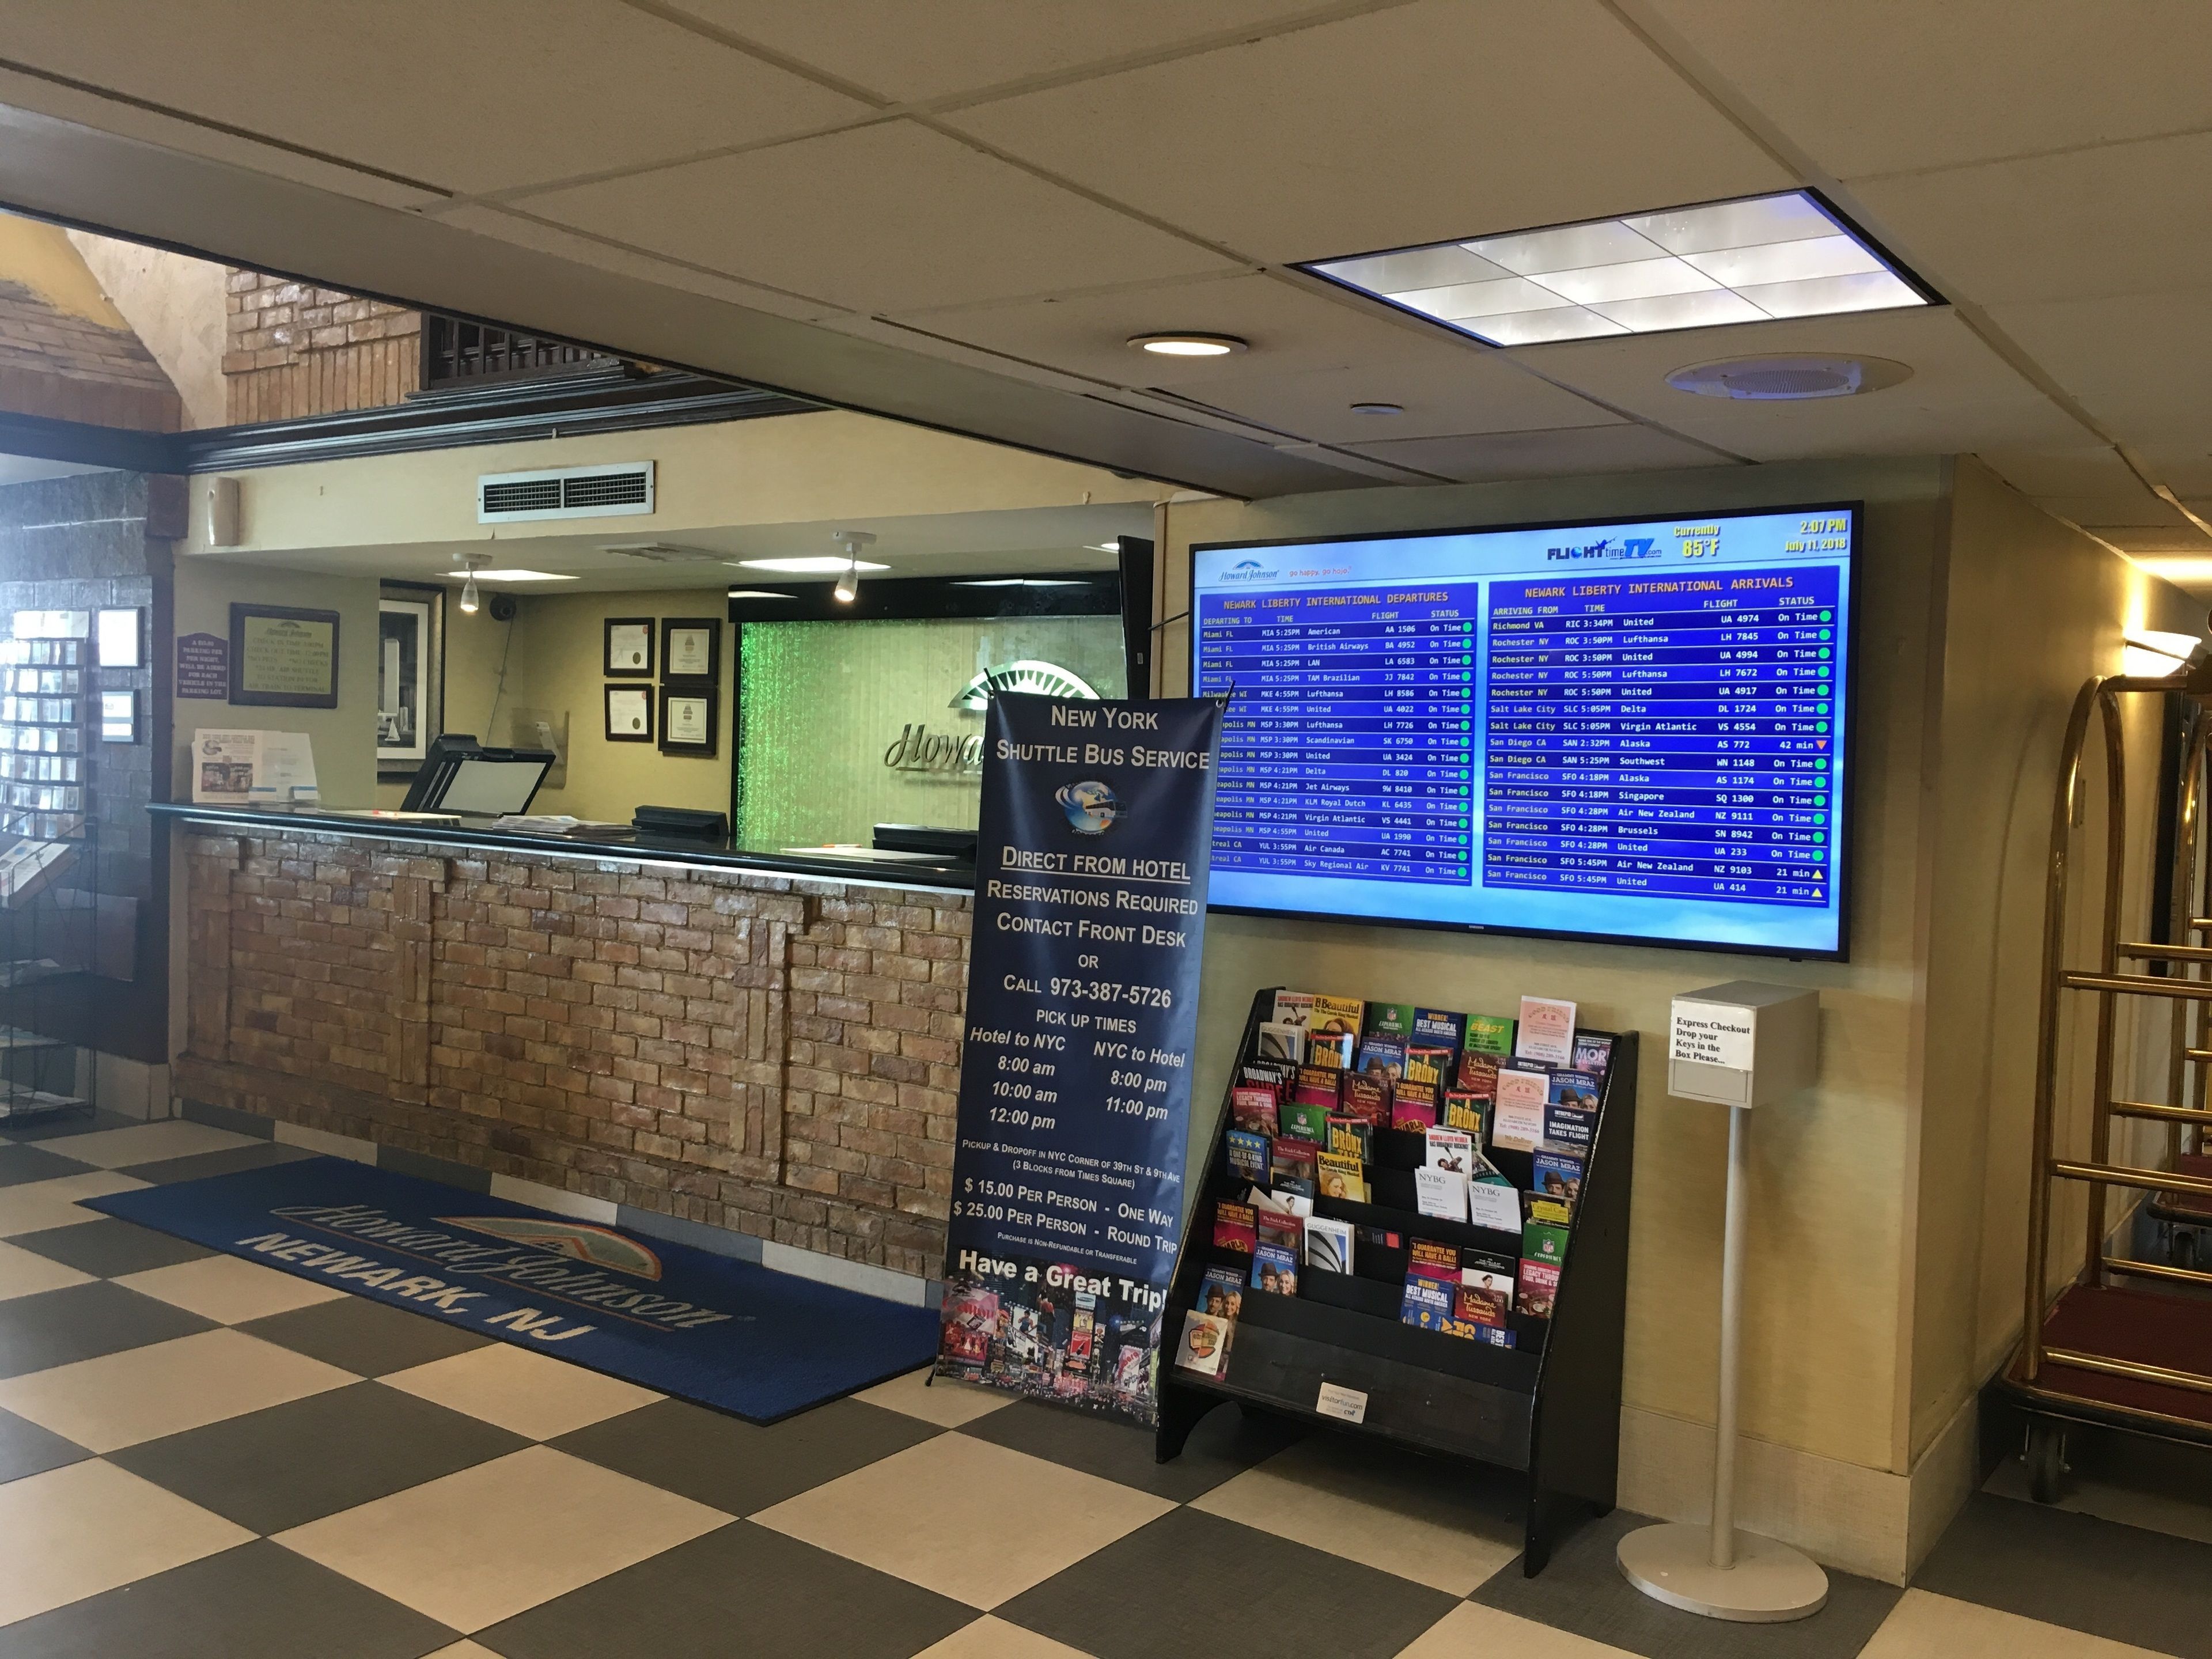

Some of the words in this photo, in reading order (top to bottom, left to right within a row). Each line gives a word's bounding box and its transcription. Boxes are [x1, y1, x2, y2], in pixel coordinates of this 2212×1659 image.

[1673, 524, 1721, 537] Currently
[1800, 520, 1825, 534] 2:07
[1827, 519, 1846, 533] PM
[1682, 538, 1721, 558] 85°F
[1785, 540, 1805, 552] July
[1807, 540, 1821, 552] 11,
[1823, 537, 1846, 550] 2018
[1219, 569, 1246, 582] Howard
[1247, 568, 1278, 582] Johnson
[1323, 568, 1331, 576] go
[1525, 587, 1566, 599] NEWARK
[1573, 584, 1622, 596] LIBERTY
[1628, 580, 1723, 594] INTERNATIONAL
[1731, 577, 1794, 590] ARRIVALS
[1224, 600, 1256, 610] NEWARK
[1262, 597, 1300, 609] LIBERTY
[1306, 594, 1381, 607] INTERNATIONAL
[1387, 592, 1448, 604] DEPARTURES
[1494, 607, 1533, 615] ARRIVING
[1537, 606, 1558, 615] FROM
[1585, 604, 1605, 612] TIME
[1703, 599, 1738, 608] FLIGHT
[1779, 597, 1815, 606] STATUS
[1203, 617, 1240, 626] DEPARTING
[1372, 611, 1399, 620] FLIGHT
[1431, 609, 1459, 618] STATUS
[1493, 621, 1530, 631] Richmond
[1534, 621, 1544, 629] VA
[1584, 619, 1613, 627] 3:34PM
[1623, 617, 1654, 626] United
[1721, 615, 1732, 623] UA
[1737, 613, 1759, 623] 4974
[1778, 613, 1790, 622] On
[1794, 612, 1818, 621] Time
[1051, 705, 1096, 727] NEW
[1102, 707, 1158, 730] YORK
[884, 724, 984, 767] Howa
[997, 739, 1077, 763] SHUTTLE
[1085, 744, 1124, 766] BUS
[1131, 745, 1209, 769] SERVICE
[1002, 845, 1067, 870] DIRECT
[1074, 855, 1126, 875] FROM
[1132, 859, 1190, 880] HOTEL
[987, 880, 1109, 907] RESERVATIONS
[1116, 890, 1198, 915] REQUIRED
[997, 912, 1073, 937] CONTACT
[1078, 920, 1136, 942] FRONT
[1142, 925, 1185, 948] DESK
[1078, 954, 1099, 969] OR
[1003, 974, 1042, 994] CALL
[1050, 977, 1172, 1007] 973-387-5726
[1036, 1009, 1066, 1026] PICK
[1071, 1013, 1089, 1028] UP
[1094, 1016, 1137, 1033] TIMES
[1471, 1022, 1505, 1033] BEAST
[1677, 1017, 1708, 1028] Express
[1710, 1022, 1751, 1034] Checkout
[970, 1027, 1010, 1045] Hotel
[1014, 1032, 1029, 1047] to
[1033, 1033, 1066, 1051] NYC
[1676, 1028, 1696, 1039] Drop
[1699, 1032, 1718, 1041] your
[1094, 1041, 1128, 1059] NYC
[1131, 1046, 1146, 1062] to
[1150, 1048, 1185, 1068] Hotel
[1676, 1039, 1695, 1050] Keys
[1698, 1041, 1705, 1050] in
[1707, 1043, 1720, 1052] the
[998, 1055, 1029, 1073] 8:00
[1033, 1062, 1055, 1076] am
[1675, 1050, 1691, 1059] Box
[1694, 1052, 1725, 1065] Please...
[1111, 1070, 1142, 1088] 8:00
[1144, 1078, 1167, 1093] pm
[1243, 1067, 1283, 1085] BROADWAY'S
[1552, 1076, 1574, 1084] JASON
[1576, 1080, 1595, 1088] MRAZ
[992, 1081, 1032, 1099] 10:00
[1035, 1088, 1058, 1103] am
[1105, 1096, 1143, 1115] 11:00
[1145, 1105, 1168, 1121] pm
[1465, 1098, 1471, 1108] A
[989, 1107, 1029, 1125] 12:00
[1031, 1114, 1056, 1130] pm
[1450, 1104, 1481, 1132] BRONX
[1549, 1120, 1589, 1133] IMAGINATION
[1549, 1128, 1567, 1137] TAKES
[1569, 1130, 1589, 1140] FLIGHT
[962, 1139, 991, 1150] PICKUP
[993, 1143, 999, 1152] &
[1002, 1143, 1036, 1157] DROPOFF
[1039, 1150, 1046, 1158] IN
[1048, 1150, 1066, 1161] NYC
[1068, 1154, 1099, 1167] CORNER
[1101, 1160, 1111, 1169] OF
[1113, 1160, 1131, 1173] 39TH
[1134, 1165, 1145, 1175] ST
[1146, 1167, 1152, 1176] &
[1153, 1168, 1167, 1178] 9TH
[1167, 1171, 1180, 1183] AVE
[1319, 1154, 1359, 1172] Beautiful
[1013, 1159, 1021, 1170] (3
[1022, 1161, 1053, 1173] BLOCKS
[1055, 1166, 1075, 1177] FROM
[1077, 1169, 1099, 1181] TIMES
[1101, 1173, 1135, 1189] SQUARE)
[1419, 1173, 1446, 1184] NYBG
[1472, 1185, 1500, 1196] NYBG
[964, 1177, 973, 1192] $
[978, 1179, 1014, 1198] 15.00
[1017, 1187, 1043, 1202] PER
[1047, 1190, 1097, 1213] PERSON
[1118, 1203, 1144, 1221] ONE
[1149, 1209, 1173, 1228] WAY
[268, 1204, 524, 1263] Howard
[953, 1200, 961, 1216] $
[967, 1202, 1003, 1220] 25.00
[1007, 1209, 1032, 1225] PER
[1036, 1213, 1087, 1236] PERSON
[1107, 1226, 1150, 1247] ROUND
[1155, 1236, 1177, 1254] TRIP
[1306, 1222, 1347, 1235] GUGGENHEIM
[997, 1232, 1027, 1244] PURCHASE
[1035, 1238, 1084, 1254] NON-REFUNDABLE
[1095, 1249, 1137, 1264] TRANSFERABLE
[235, 1232, 491, 1315] NEWARK,
[484, 1306, 600, 1342] NJ
[959, 1249, 1017, 1278] Have
[1025, 1265, 1038, 1282] a
[1046, 1265, 1111, 1297] Great
[1119, 1279, 1167, 1312] Trip!
[442, 1255, 734, 1330] Johnson
[1406, 1284, 1421, 1296] BEST
[1422, 1288, 1448, 1302] MUSICAL
[1464, 1292, 1496, 1308] Madame
[1464, 1302, 1495, 1317] Tussauds
[1322, 1395, 1363, 1410] visitorfun.com
